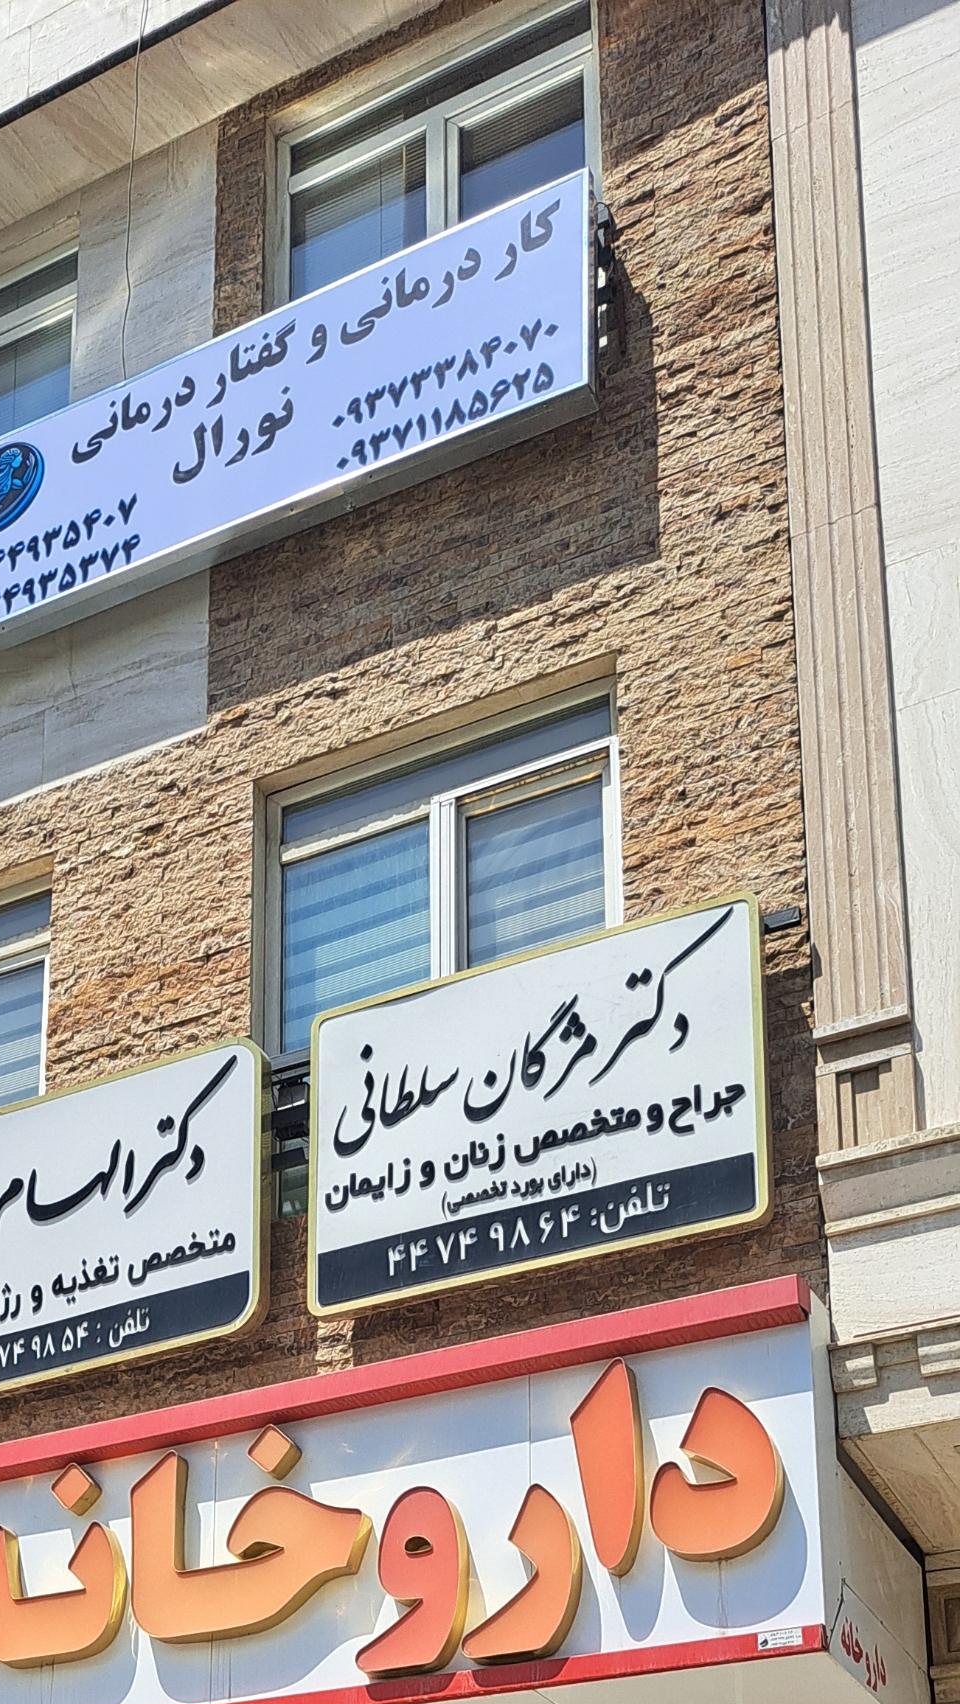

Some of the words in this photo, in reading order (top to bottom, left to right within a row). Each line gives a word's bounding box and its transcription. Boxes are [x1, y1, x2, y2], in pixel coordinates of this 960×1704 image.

[496, 200, 560, 280] کار
[340, 248, 481, 346] درمانی
[206, 319, 296, 408] گفتار
[306, 323, 327, 362] و
[332, 318, 559, 428] ۰۹۳۷۳۳۸۴۰۷۰
[71, 375, 196, 464] درمانی
[173, 385, 294, 484] نورال
[336, 362, 554, 469] ۰۹۳۷۱۱۸۵۶۲۵
[589, 906, 734, 1085] دکتر
[464, 995, 597, 1121] مژگان
[333, 1044, 459, 1157] سلطانی
[647, 1103, 664, 1132] و
[668, 1082, 746, 1134] جراح
[124, 1055, 238, 1213] دکتر
[444, 1134, 505, 1180] زنان
[514, 1108, 641, 1161] متخصص
[324, 1158, 410, 1211] زایمان
[419, 1160, 435, 1187] و
[510, 1176, 544, 1199] بورد
[590, 1182, 670, 1235] تلفن:
[51, 1256, 120, 1301] تغذیه
[128, 1229, 236, 1284] متخصص
[31, 1284, 43, 1311] و
